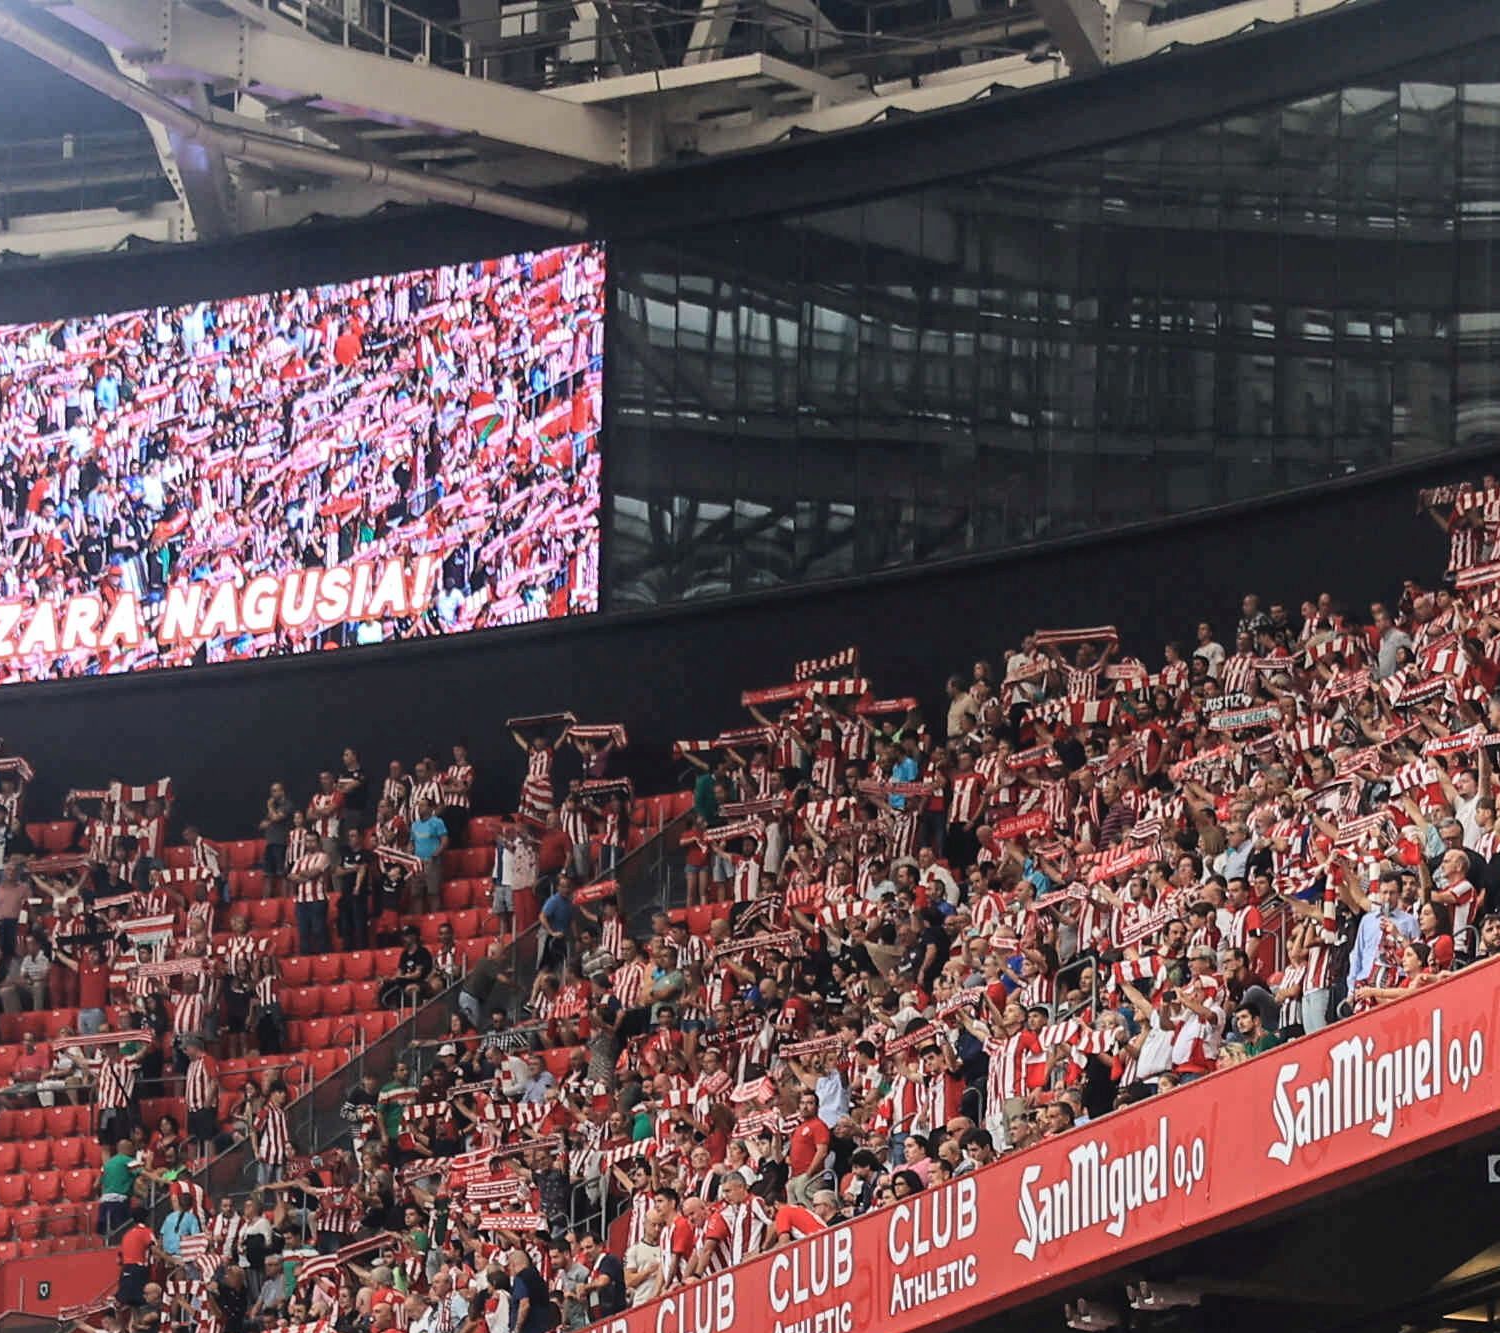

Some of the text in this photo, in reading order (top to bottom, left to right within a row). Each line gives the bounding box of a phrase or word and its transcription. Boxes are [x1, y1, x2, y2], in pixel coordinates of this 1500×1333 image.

[158, 556, 442, 645] NAGUSIA!
[888, 1178, 977, 1266] CLUB
[769, 1227, 852, 1313] CLUB
[890, 1254, 977, 1315] ATHLETIC
